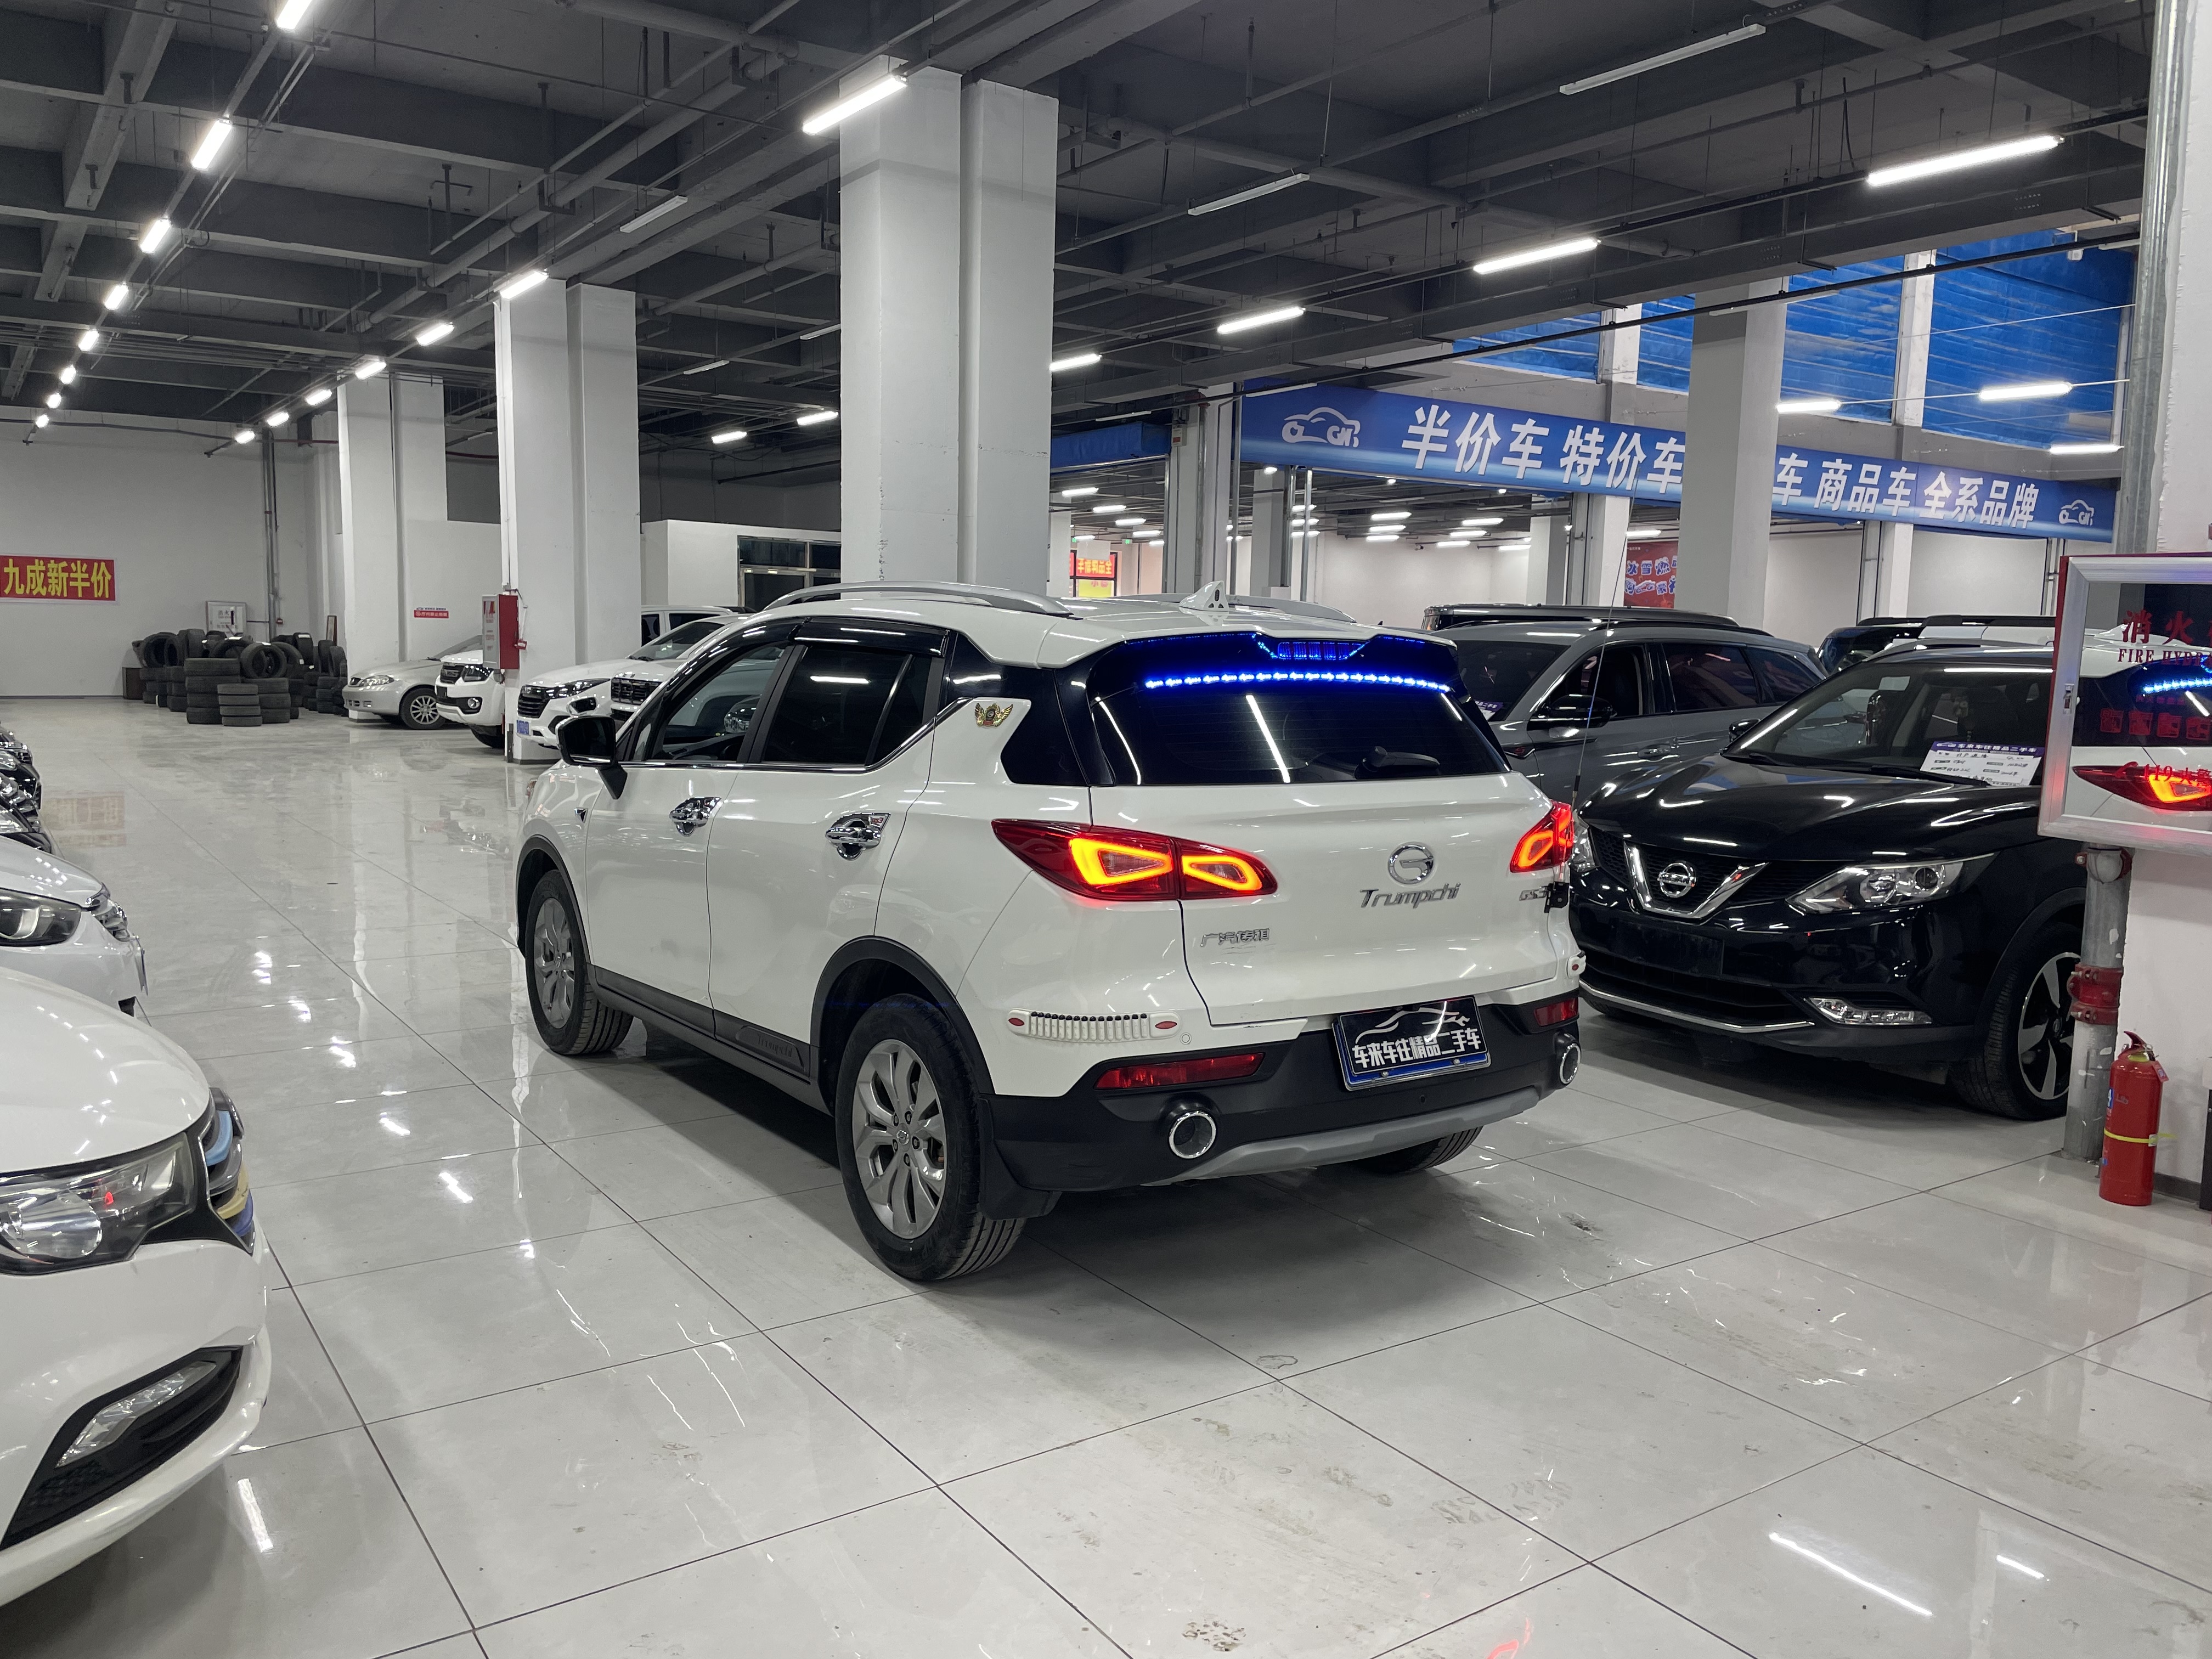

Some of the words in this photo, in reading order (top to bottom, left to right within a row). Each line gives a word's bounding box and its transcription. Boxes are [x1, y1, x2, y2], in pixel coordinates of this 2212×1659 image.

[1401, 404, 1550, 480] 半价车
[1560, 424, 1685, 494] 特价车
[1814, 459, 1916, 517] 商品车
[1918, 472, 2040, 528] 全系品牌
[4, 558, 112, 599] 九成新半价
[2122, 610, 2212, 648] 消火
[2118, 648, 2154, 664] FIRE
[1359, 882, 1462, 909] Trumpchi
[1200, 928, 1270, 947] 广汽传祺
[1352, 1028, 1482, 1069] 车来车往精品二手车
